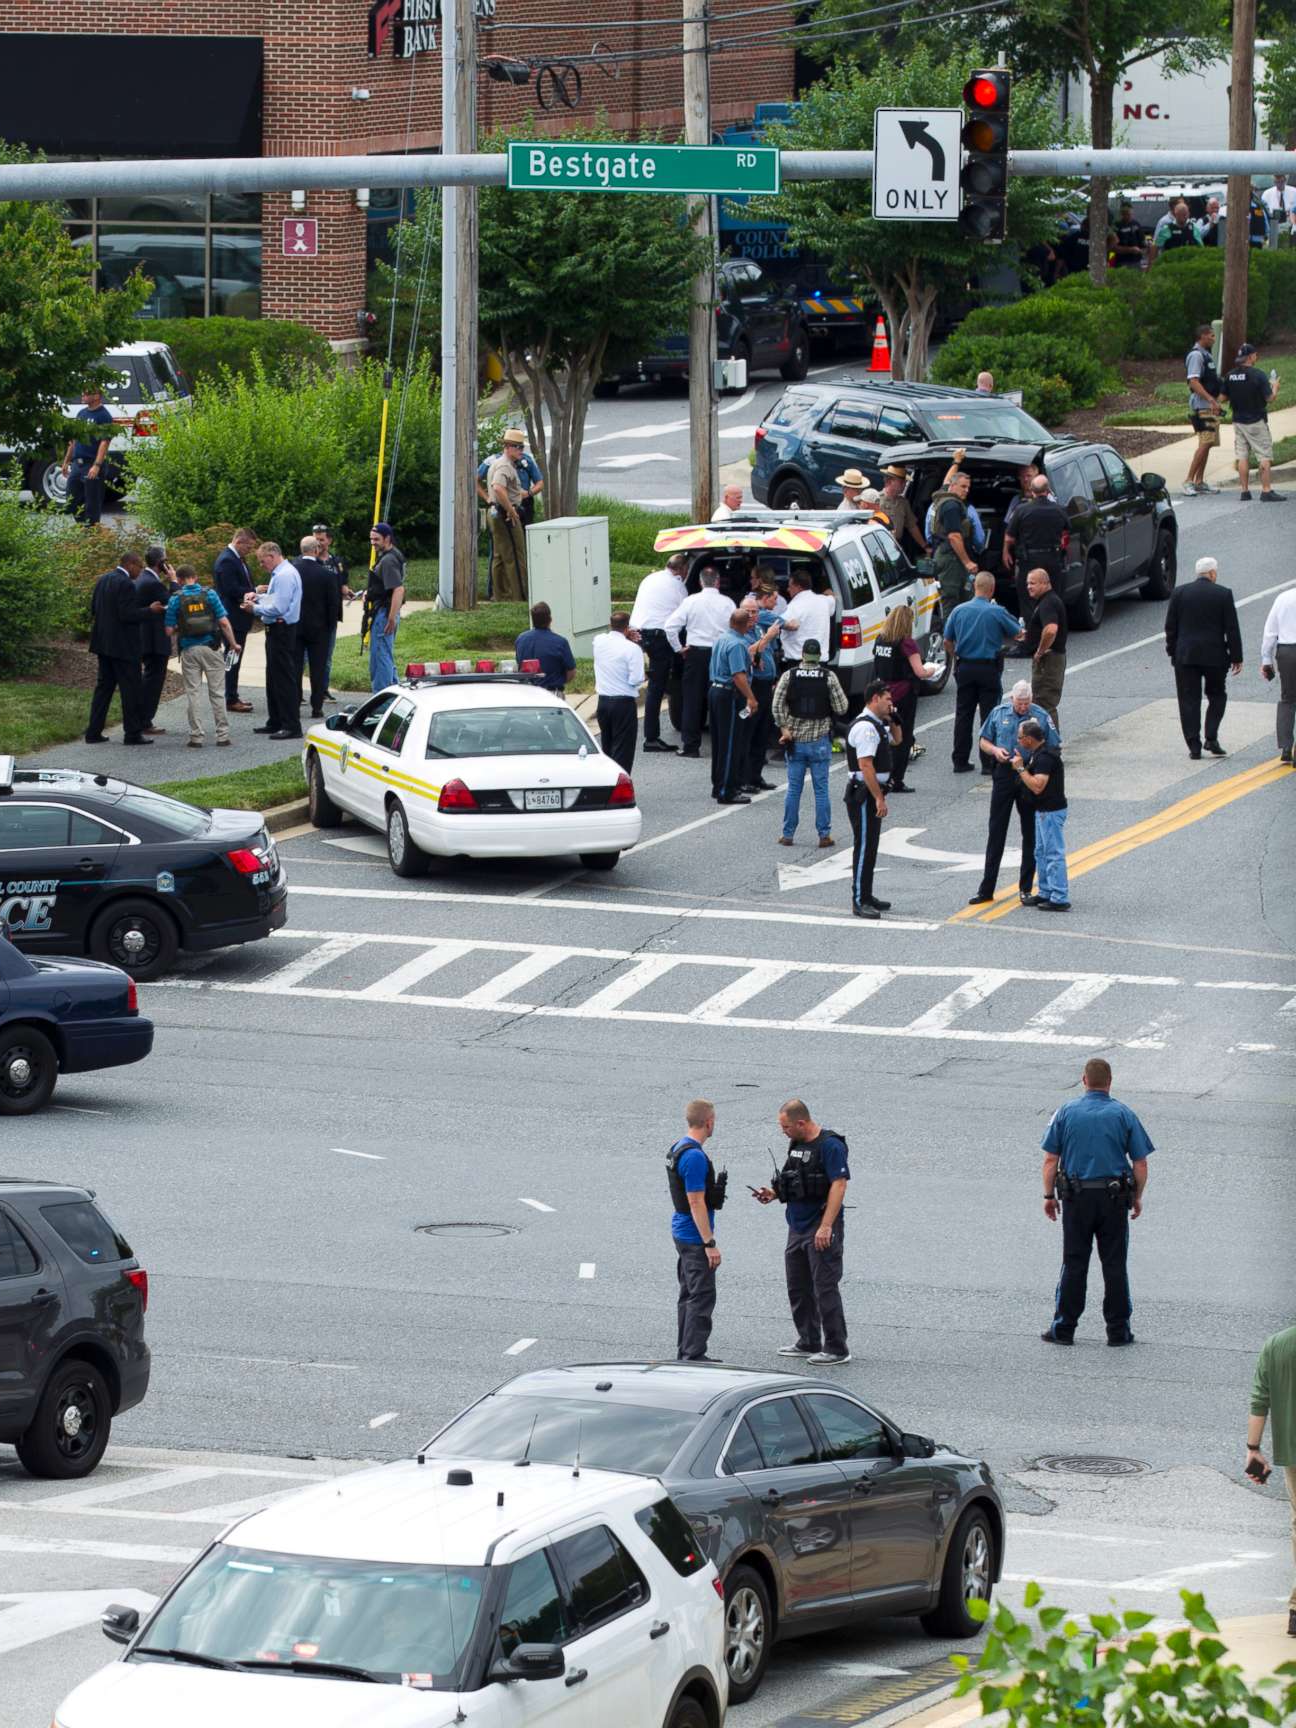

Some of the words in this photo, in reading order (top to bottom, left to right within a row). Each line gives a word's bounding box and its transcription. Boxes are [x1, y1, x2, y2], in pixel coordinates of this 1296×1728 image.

[404, 0, 437, 20] FIRST
[404, 25, 437, 58] BANK
[529, 150, 656, 185] Bestgate
[736, 153, 757, 167] RD
[886, 188, 948, 209] ONLY
[736, 230, 789, 245] COUNT
[1229, 373, 1246, 381] POLICE
[875, 645, 892, 657] POLICE
[6, 880, 60, 894] COUNTY
